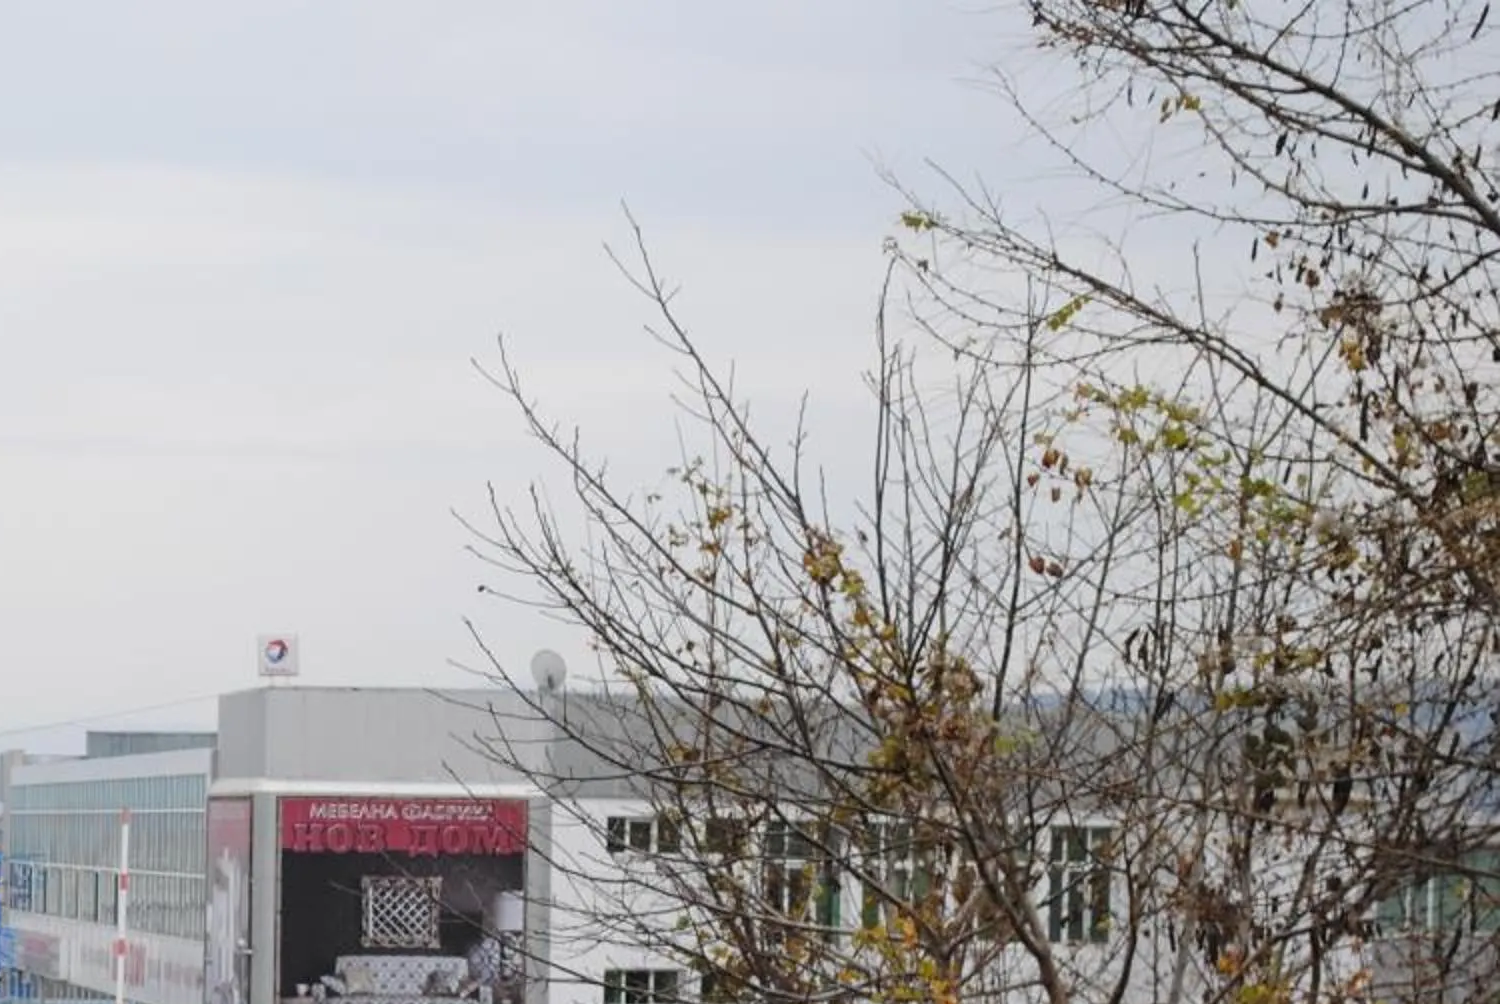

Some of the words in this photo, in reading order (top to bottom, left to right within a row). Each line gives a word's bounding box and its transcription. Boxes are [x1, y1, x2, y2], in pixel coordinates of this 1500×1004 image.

[308, 802, 399, 820] МЕБЕЛНА
[293, 823, 387, 853] НОВ
[408, 825, 514, 857] ДОМ
